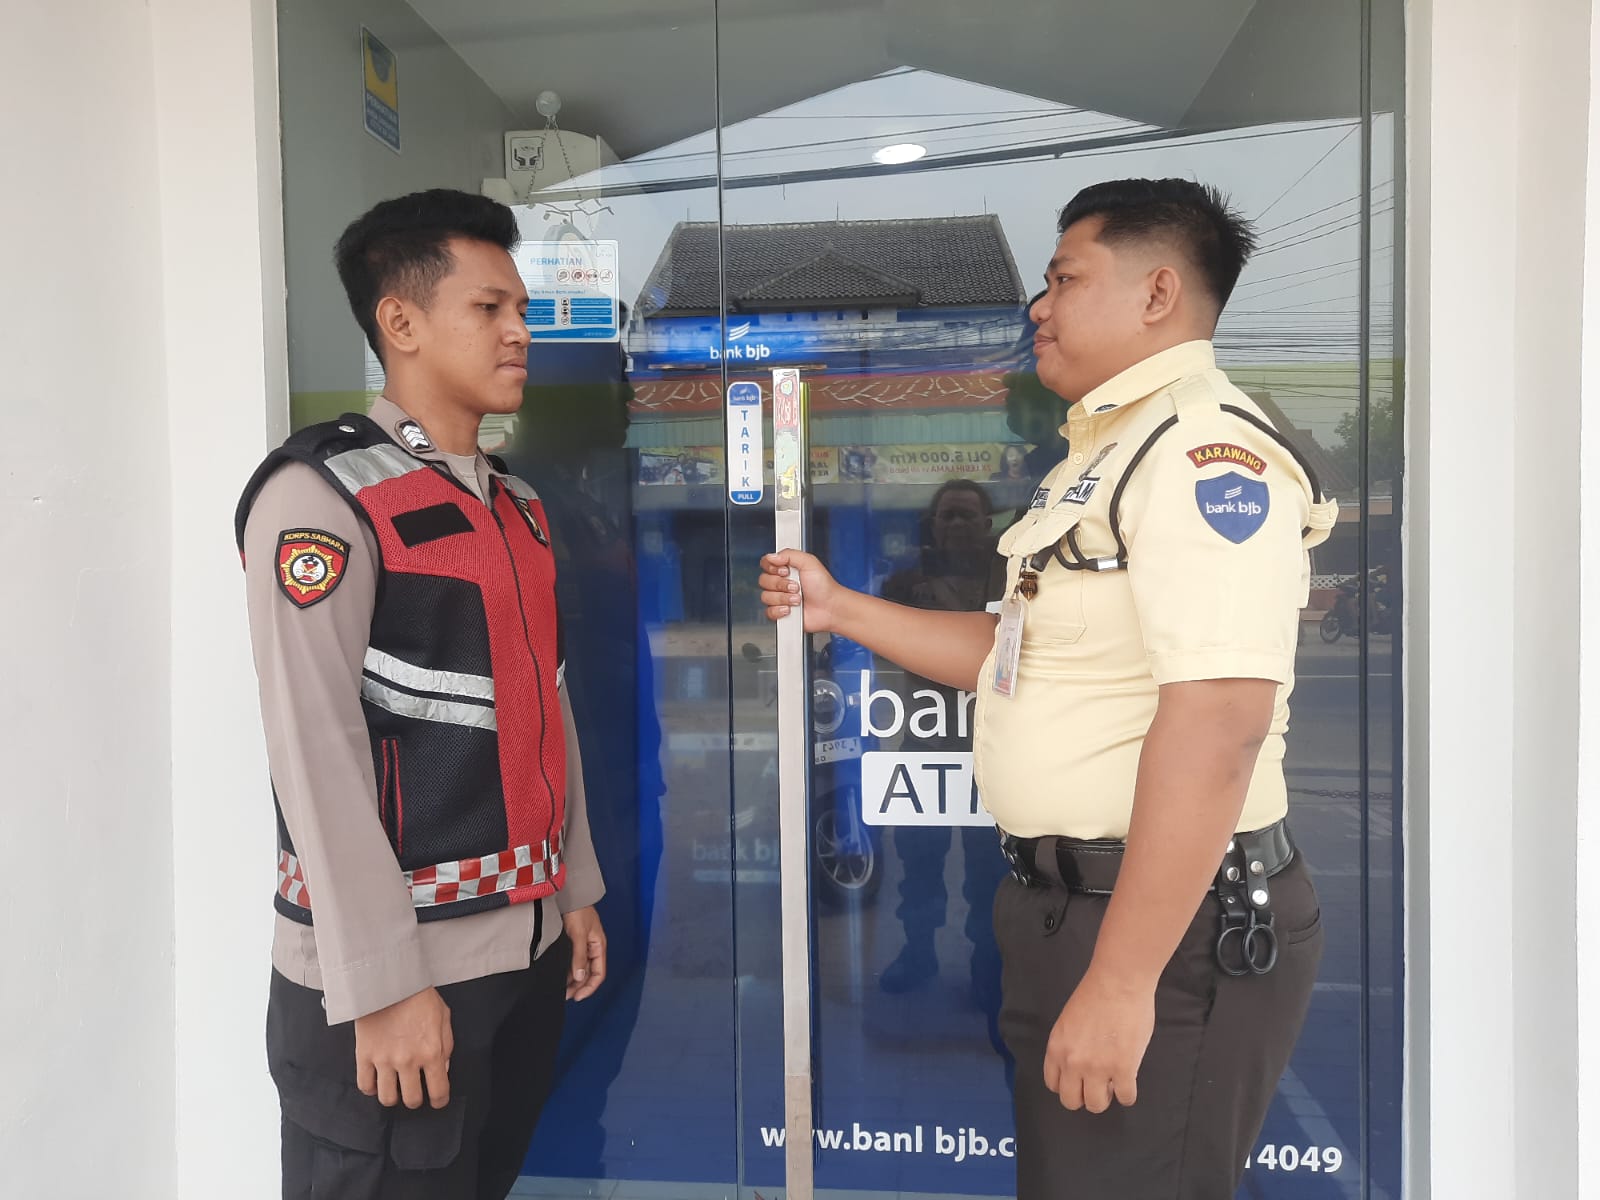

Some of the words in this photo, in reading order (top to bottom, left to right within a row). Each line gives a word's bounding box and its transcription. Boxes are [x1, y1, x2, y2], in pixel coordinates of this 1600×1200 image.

[529, 257, 583, 266] PERHATIAN
[745, 343, 771, 361] bjb
[740, 409, 750, 487] TARIK
[1194, 446, 1262, 471] KARAWANG
[737, 493, 755, 501] PULL
[1206, 501, 1237, 514] bank
[1238, 501, 1262, 516] bjb
[283, 532, 311, 541] KORPS
[311, 533, 345, 553] SABHARA
[935, 1125, 1018, 1163] bjb.c
